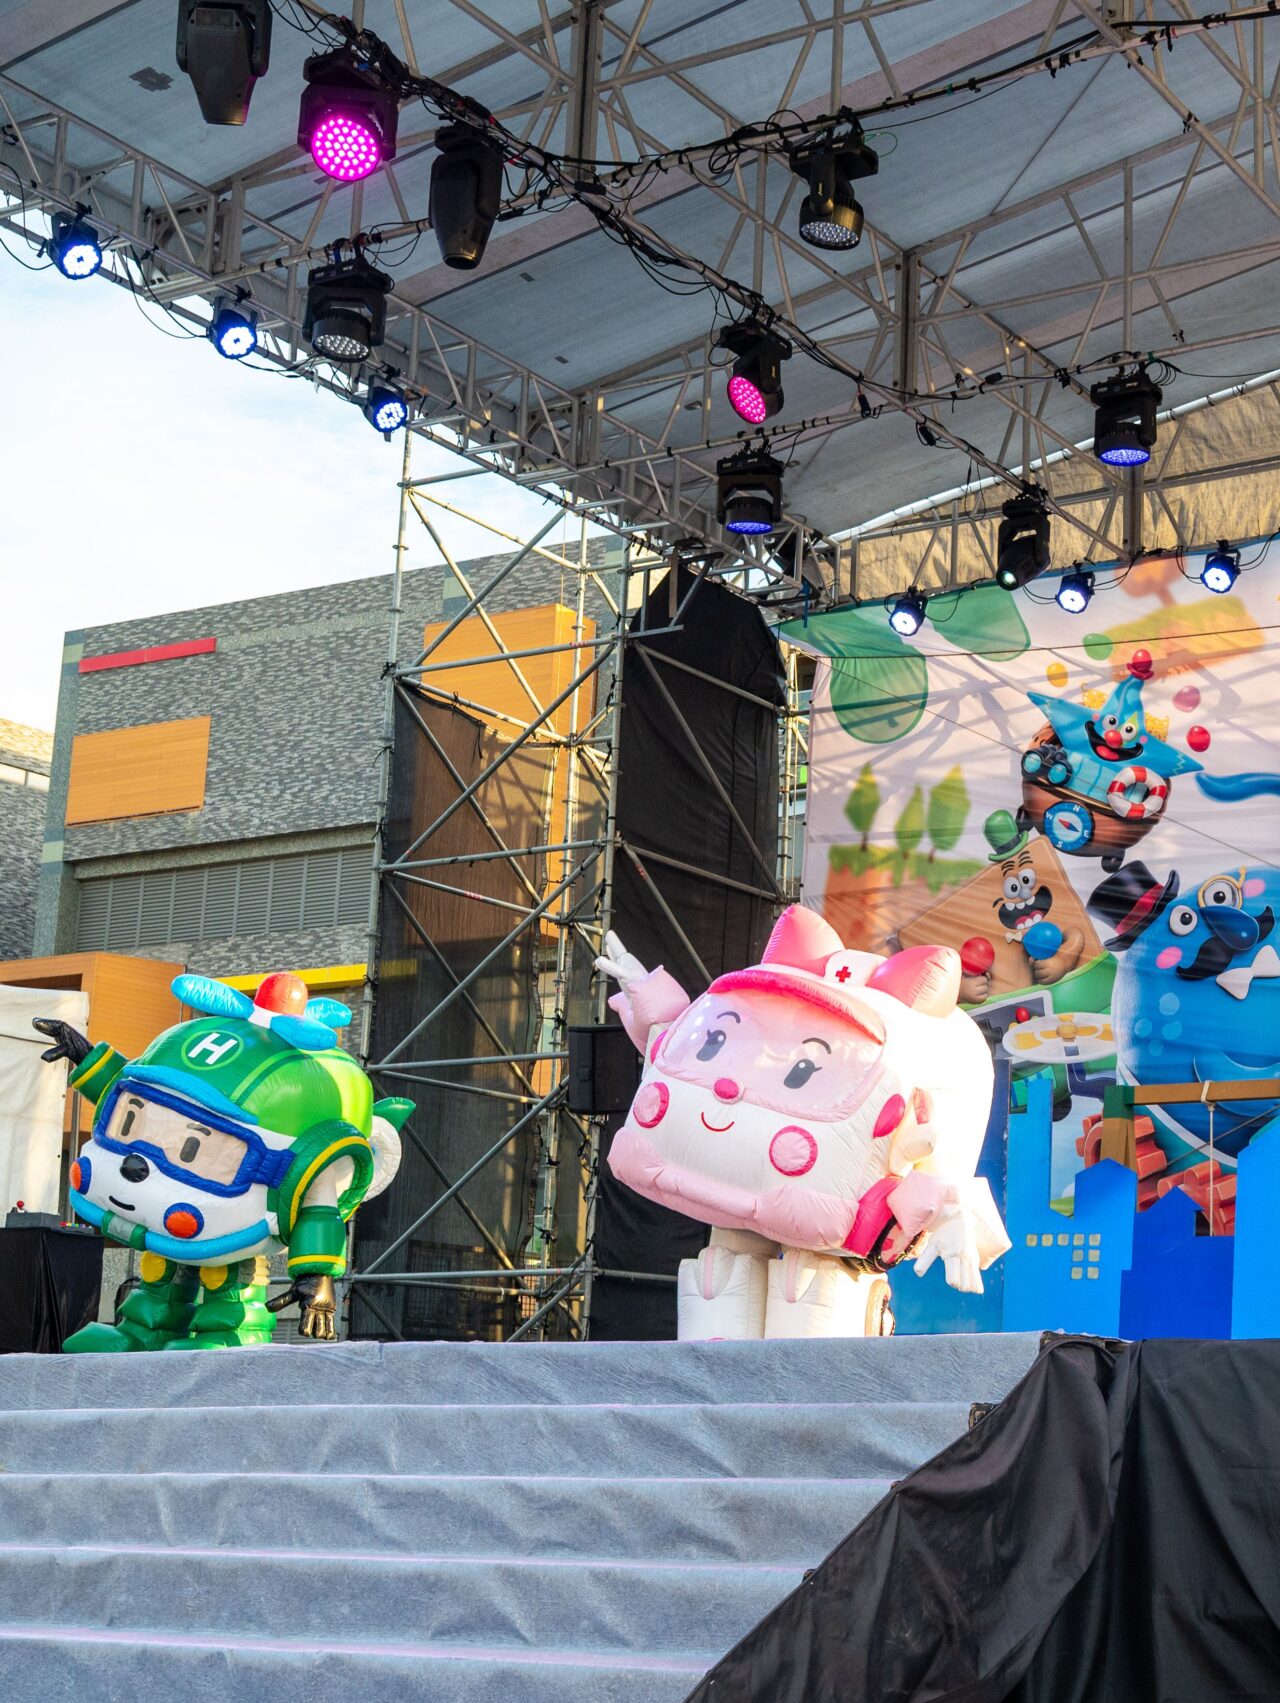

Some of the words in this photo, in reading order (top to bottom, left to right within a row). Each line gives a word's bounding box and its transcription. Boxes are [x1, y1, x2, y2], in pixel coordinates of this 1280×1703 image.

[1073, 804, 1080, 812] N
[1046, 811, 1053, 820] W
[1083, 830, 1089, 838] E
[187, 1032, 238, 1065] H
